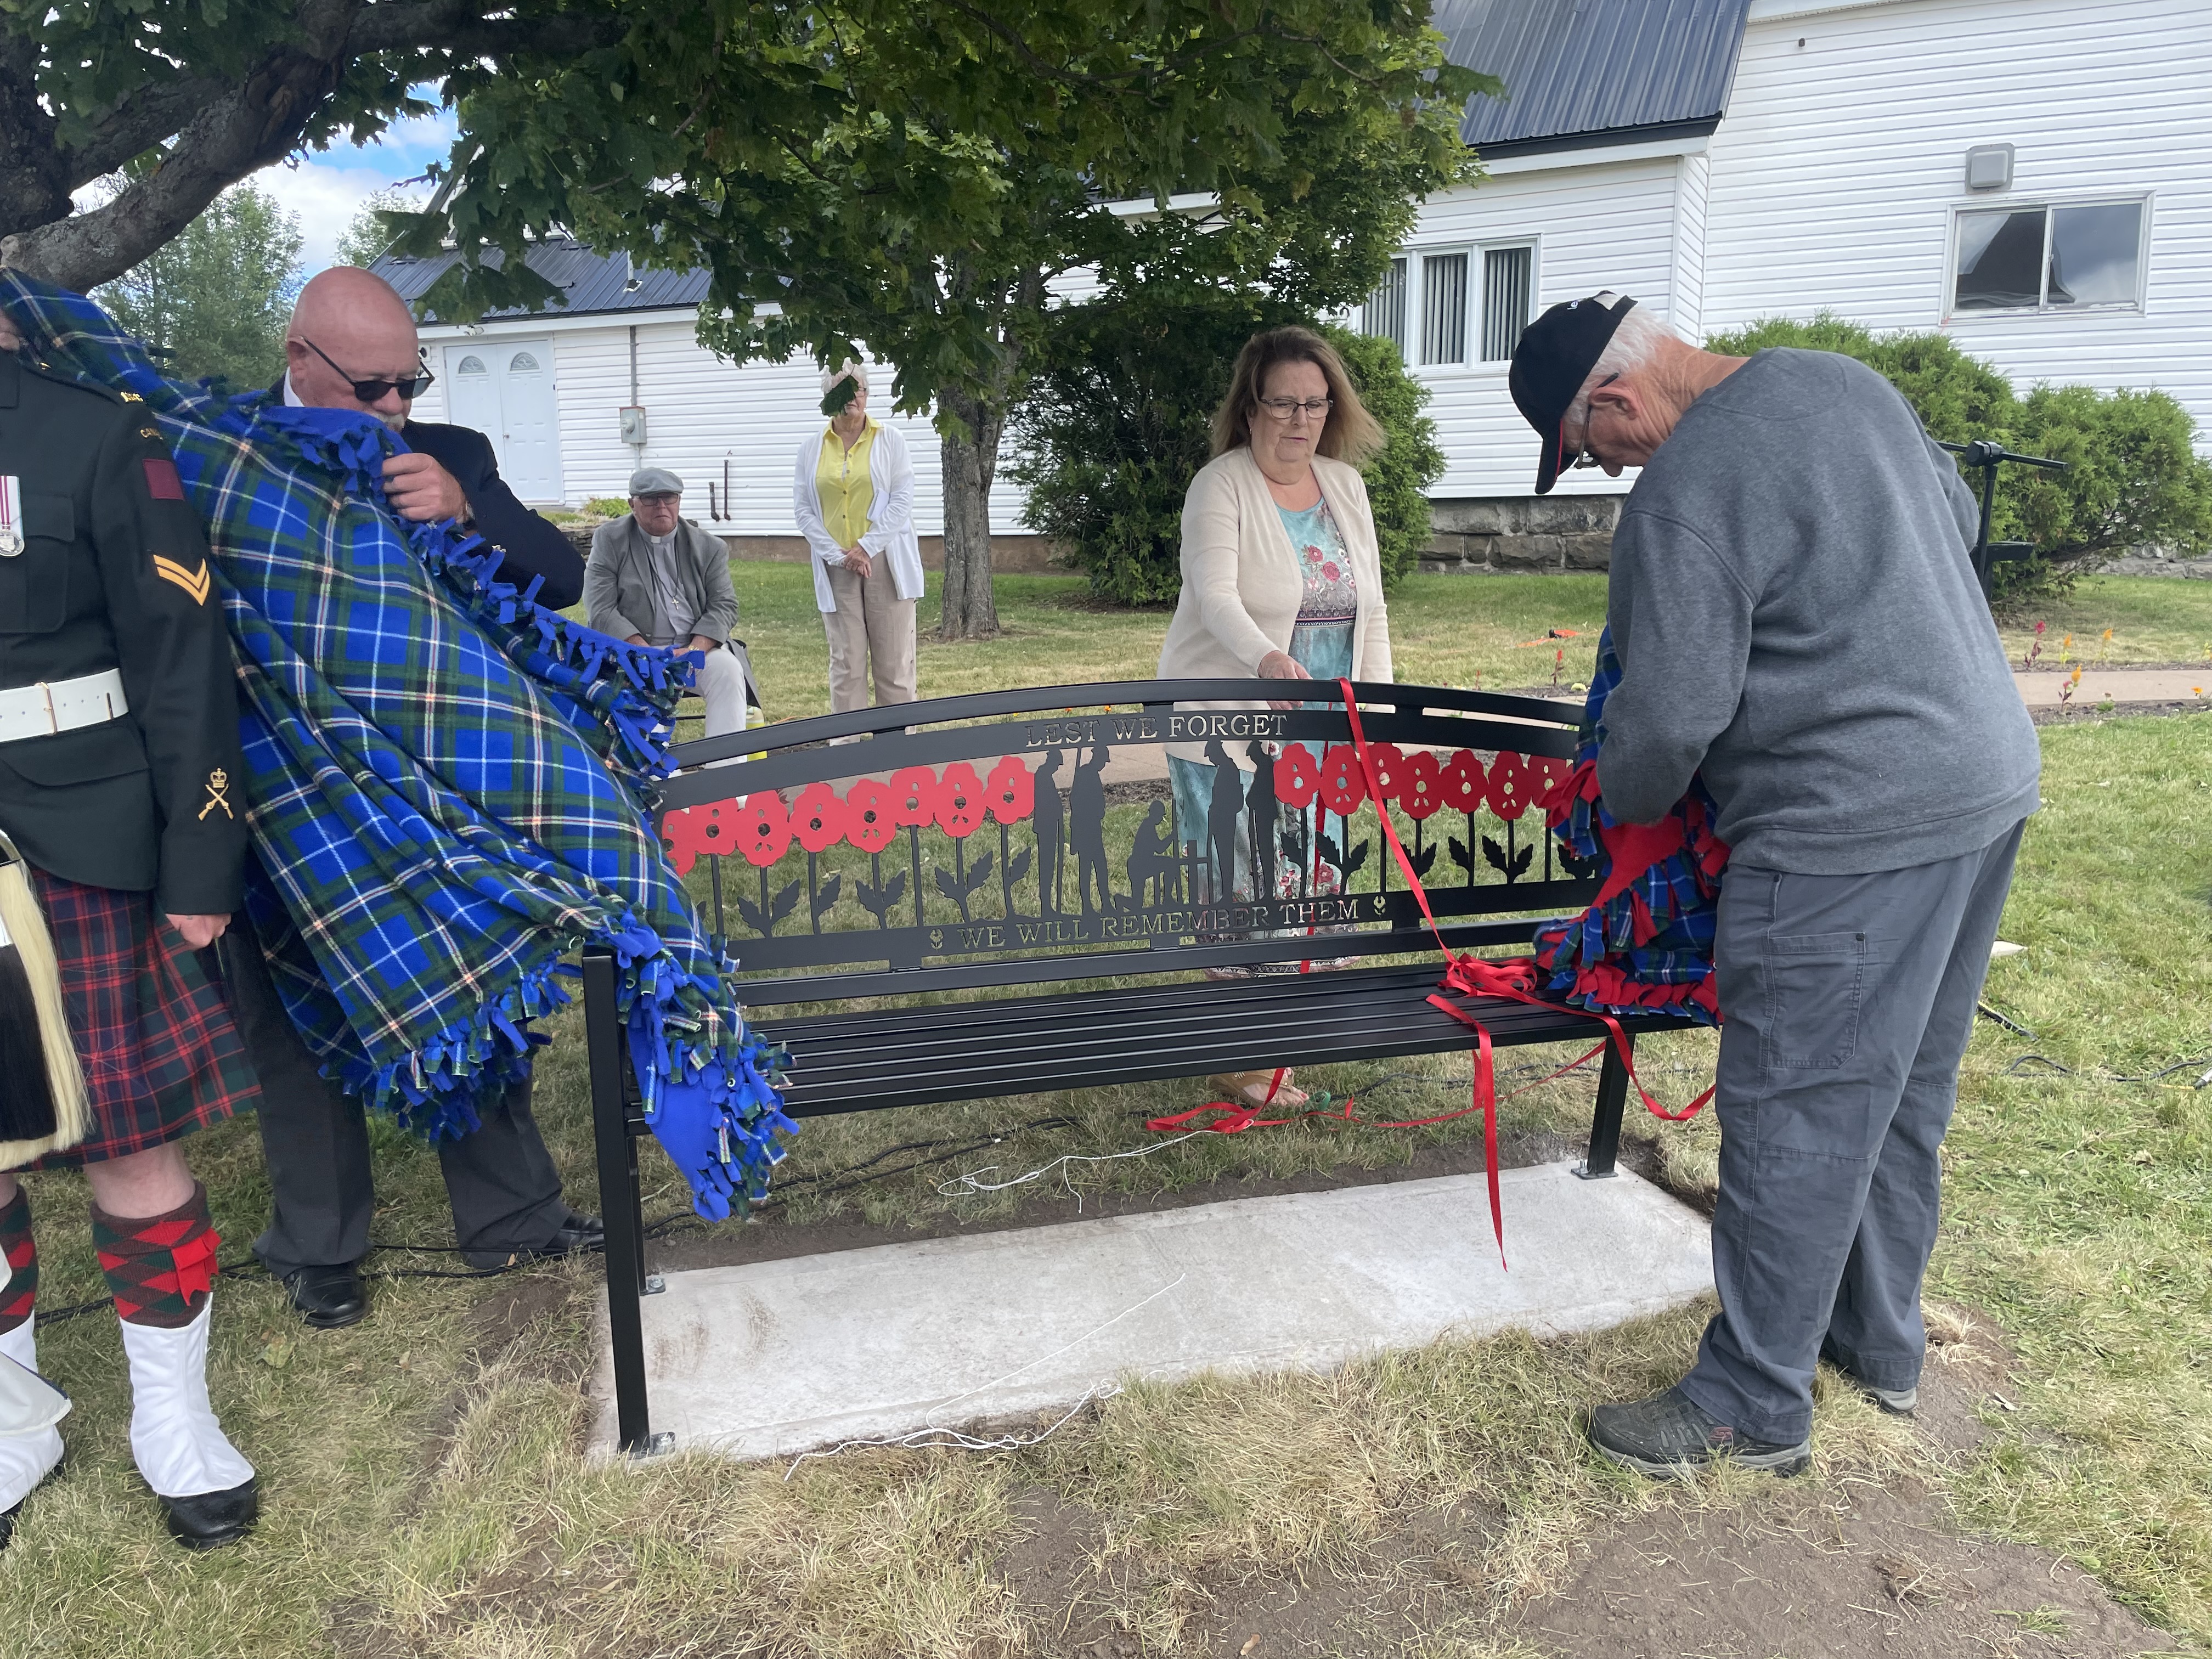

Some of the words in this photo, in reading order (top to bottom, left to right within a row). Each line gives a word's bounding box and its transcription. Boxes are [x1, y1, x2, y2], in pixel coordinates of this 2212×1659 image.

[1024, 719, 1100, 748] LEST
[1110, 716, 1158, 740] WE
[1169, 714, 1288, 737] FORGET
[957, 926, 1006, 949] WE
[1015, 919, 1090, 945] WILL
[1099, 906, 1271, 939] REMEMBER
[1278, 899, 1359, 924] THEM
